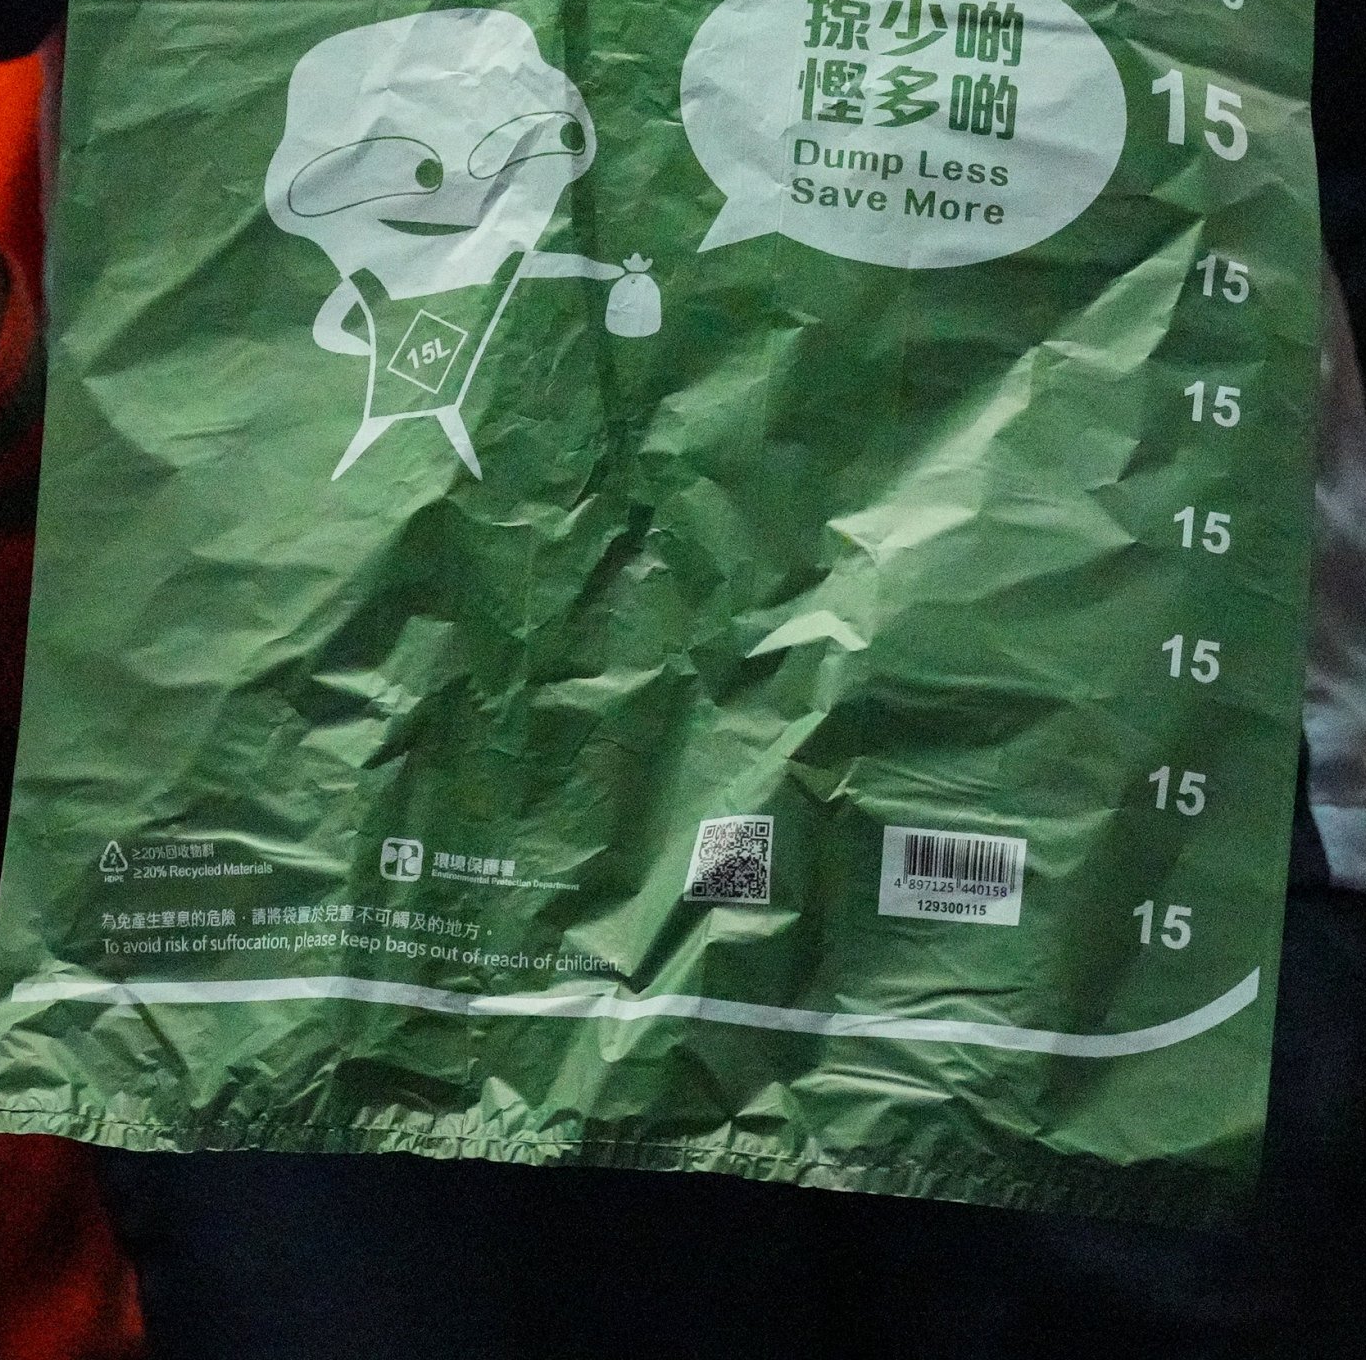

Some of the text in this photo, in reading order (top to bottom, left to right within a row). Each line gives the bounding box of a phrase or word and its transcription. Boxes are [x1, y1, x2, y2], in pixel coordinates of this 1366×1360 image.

[798, 57, 1018, 140] 慳多啲
[1152, 68, 1248, 161] 15
[793, 139, 1009, 186] Dump Less
[790, 177, 1005, 225] Save More
[1196, 255, 1250, 303] 15
[407, 337, 451, 369] 15L
[1184, 380, 1241, 426] 15
[1172, 506, 1231, 554] 15
[1162, 634, 1221, 683] 15
[1149, 765, 1206, 816] 15
[169, 864, 221, 880] Recycled
[223, 862, 273, 876] Materials
[894, 878, 1008, 898] 4 897125 440158
[917, 899, 987, 916] 129300115
[1133, 899, 1191, 950] 15
[102, 939, 119, 954] To
[123, 937, 161, 954] avoid
[165, 936, 187, 952] risk
[192, 935, 209, 951] of
[210, 933, 291, 951] suffocation,
[294, 931, 337, 952] please
[340, 930, 380, 953] keep
[385, 934, 426, 957] bags
[431, 944, 458, 962] out
[462, 947, 480, 964] of
[485, 952, 528, 968] reach
[534, 953, 553, 970] of
